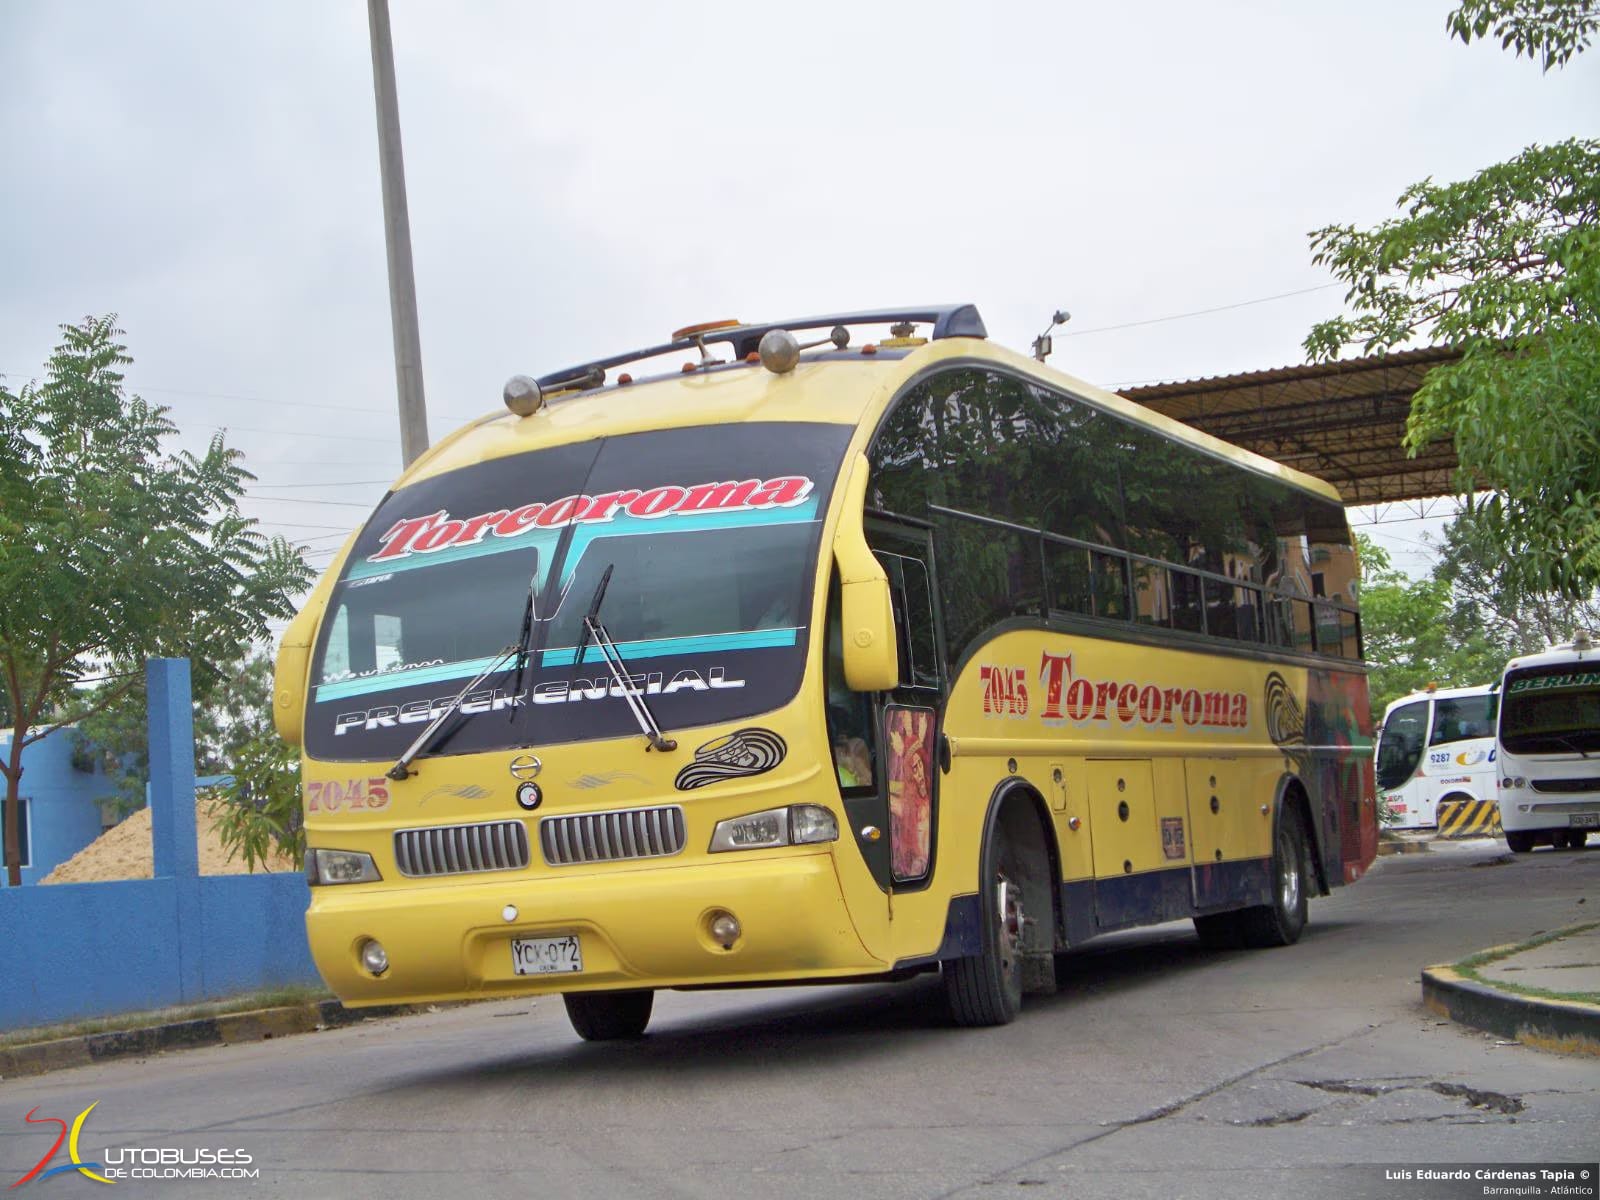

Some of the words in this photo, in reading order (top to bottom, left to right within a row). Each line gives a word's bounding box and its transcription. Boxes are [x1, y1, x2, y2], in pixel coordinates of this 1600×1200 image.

[367, 475, 815, 564] Torcoroma
[980, 665, 1029, 717] 7045
[1038, 649, 1249, 731] Torcoroma
[1430, 753, 1451, 764] 9287
[307, 777, 389, 812] 7045
